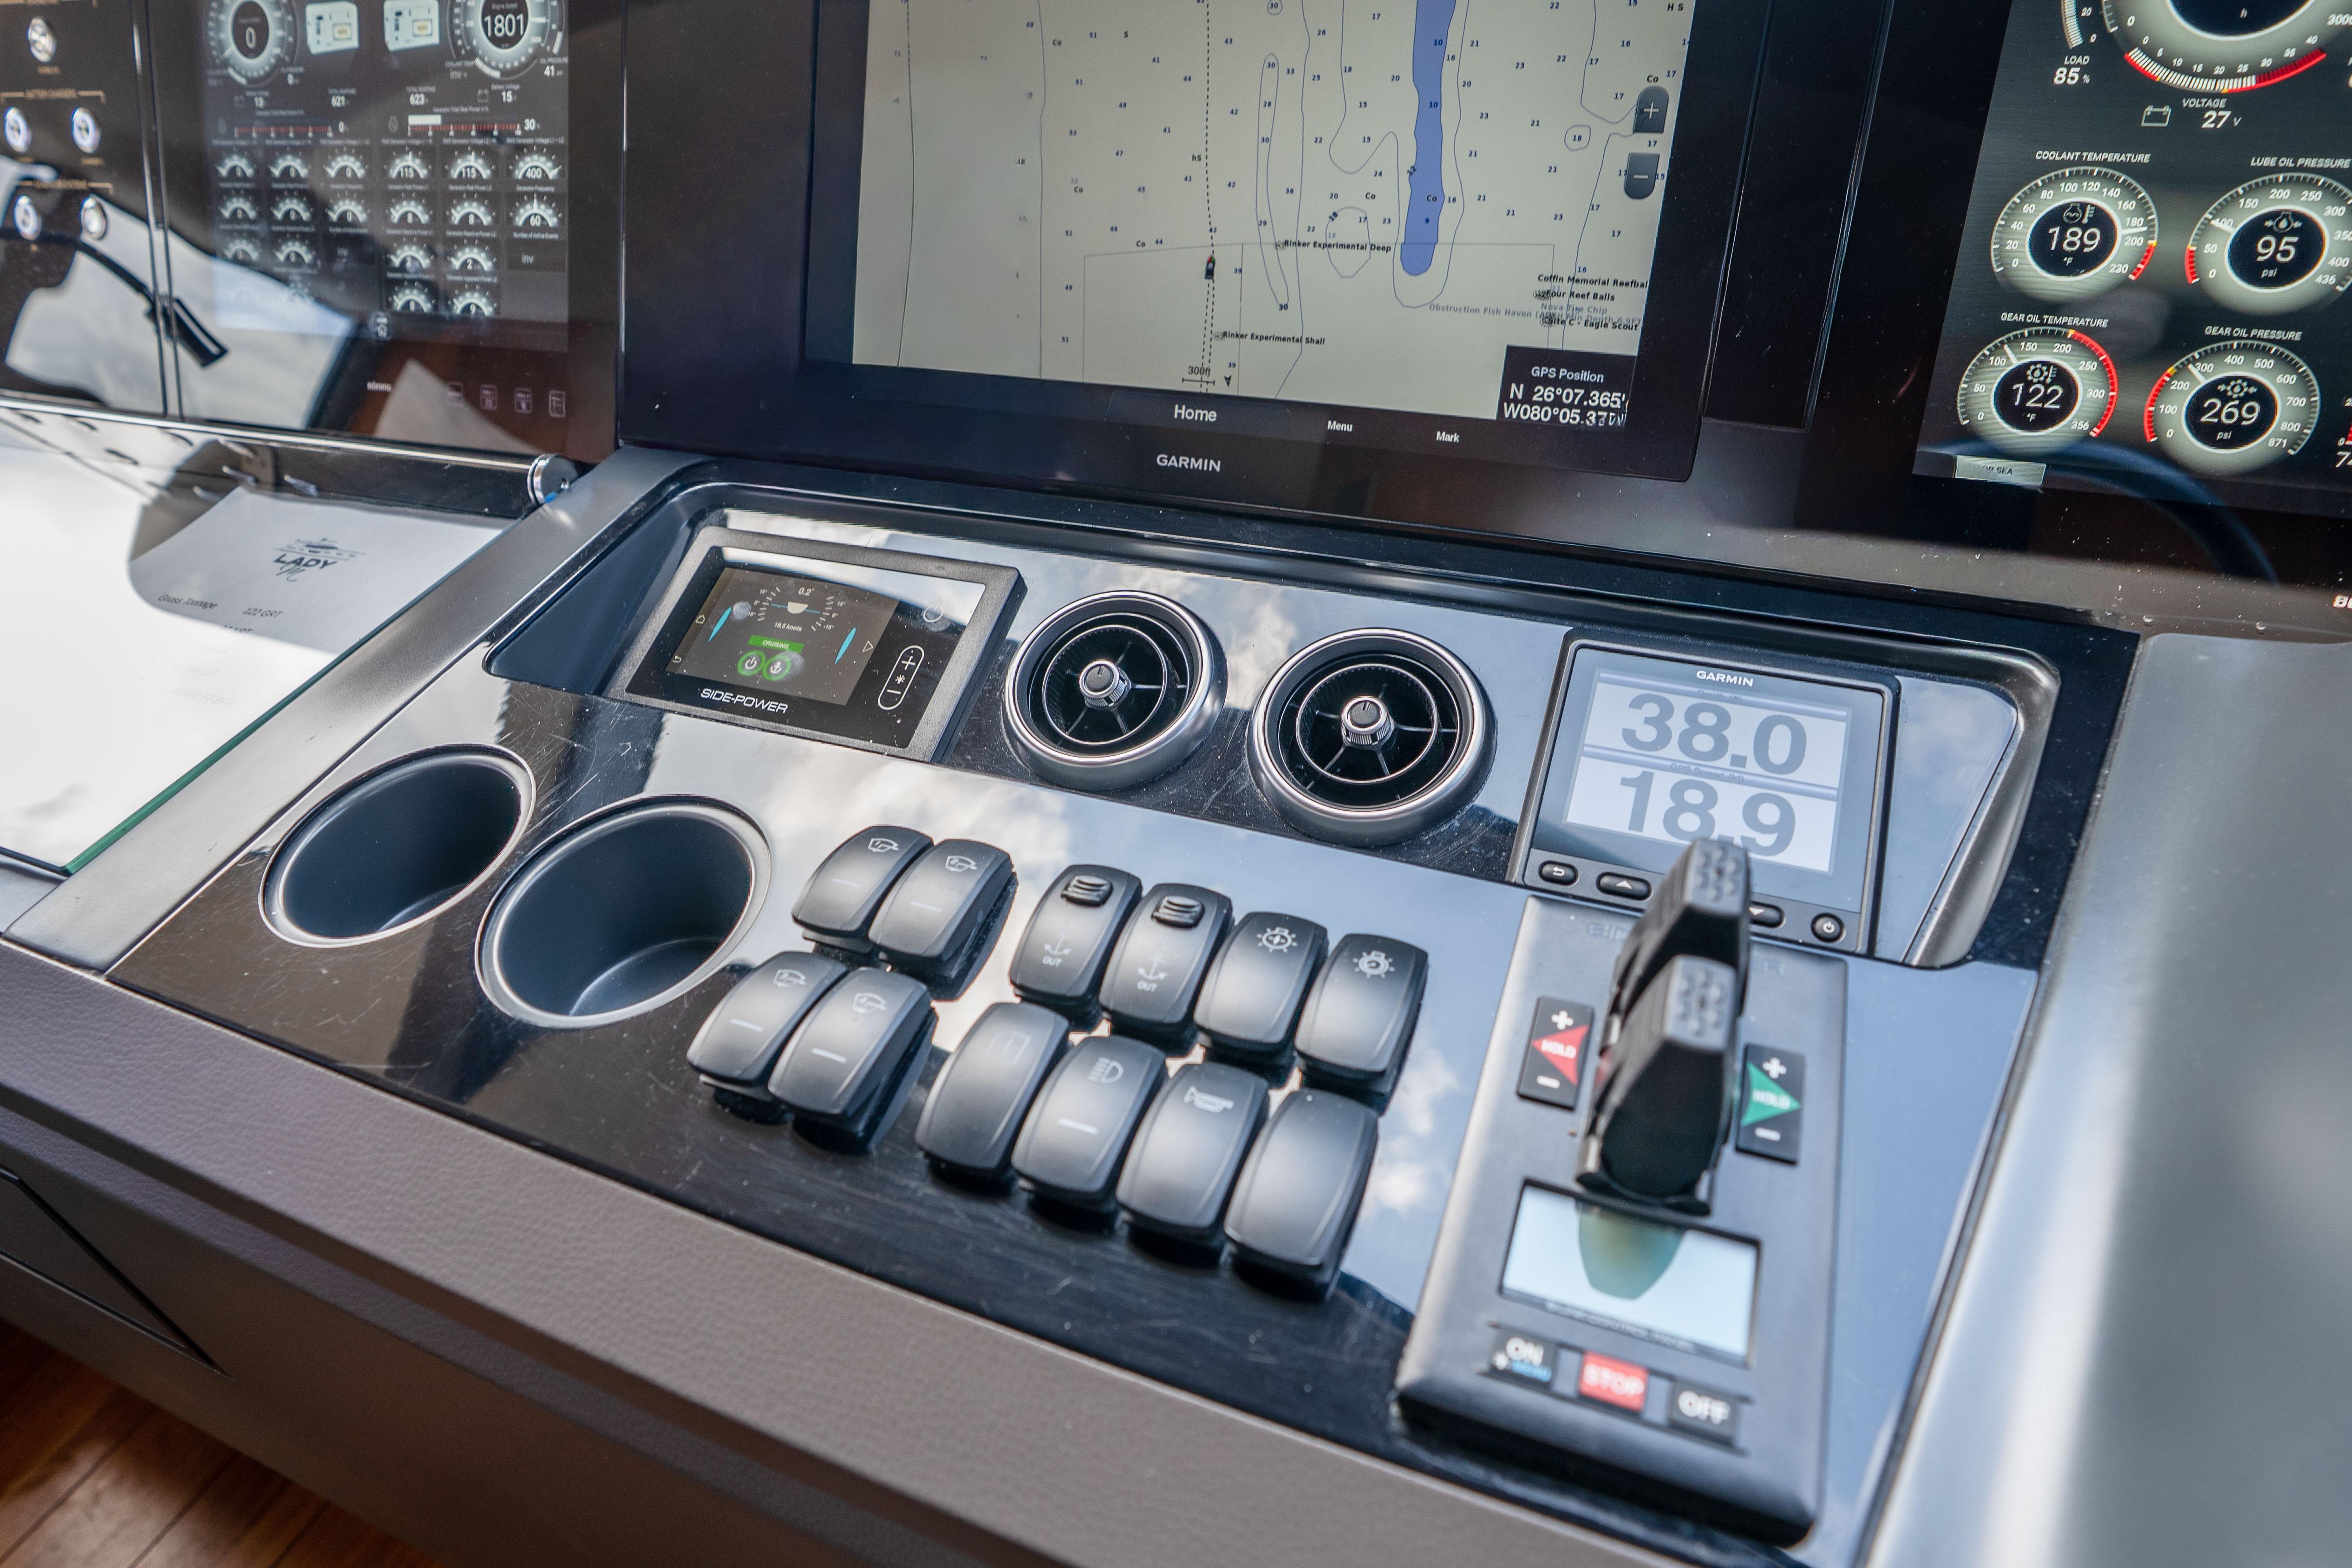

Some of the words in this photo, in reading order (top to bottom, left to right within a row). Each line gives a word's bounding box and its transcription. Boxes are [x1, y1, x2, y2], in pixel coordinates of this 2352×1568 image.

[2080, 7, 2092, 17] 20
[484, 13, 525, 38] 1801
[2127, 15, 2136, 27] 0
[2090, 33, 2097, 43] 0
[2142, 35, 2149, 45] 0
[2064, 55, 2090, 65] LOAD
[2172, 57, 2183, 67] 10
[543, 65, 555, 77] 41
[2053, 67, 2081, 85] 85
[2082, 74, 2091, 84] %
[1646, 74, 1659, 83] Co
[409, 93, 425, 105] 623
[2182, 98, 2228, 108] VOLTAGE
[523, 118, 536, 131] 30
[2201, 110, 2232, 129] 27
[2035, 150, 2081, 162] COOLANT
[2081, 151, 2152, 163] TEMPERATURE
[2250, 156, 2278, 167] LUBE
[2278, 157, 2295, 168] OIL
[2296, 157, 2352, 169] PRESSURE
[462, 167, 476, 178] 115
[525, 167, 542, 179] 400
[1074, 185, 1084, 194] Co
[2059, 182, 2078, 193] 100
[2082, 181, 2101, 192] 120
[2102, 187, 2121, 198] 140
[2040, 189, 2054, 200] 80
[2268, 188, 2291, 200] 200
[2300, 190, 2323, 202] 250
[2022, 203, 2036, 214] 60
[2117, 200, 2136, 211] 160
[2238, 197, 2260, 209] 150
[529, 215, 542, 227] 60
[2010, 220, 2024, 231] 40
[2125, 216, 2144, 228] 180
[2047, 225, 2101, 253] 189
[2123, 236, 2144, 247] 200
[1284, 239, 1311, 249] Rinker
[1313, 240, 1368, 252] Experimental
[1370, 243, 1392, 254] Deep
[2005, 240, 2019, 251] 20
[2203, 243, 2218, 254] 50
[2255, 235, 2299, 263] 95
[2011, 258, 2019, 268] 0
[2328, 256, 2350, 268] 400
[2208, 268, 2217, 279] 0
[2261, 268, 2278, 279] psi
[1537, 273, 1564, 284] Coffin
[1567, 275, 1610, 287] Memorial
[1569, 290, 1591, 301] Reef
[1592, 292, 1616, 302] Balls
[1429, 303, 1480, 315] Obstruction
[1483, 307, 1502, 315] Fish
[1504, 308, 1532, 318] Haven
[1541, 302, 1564, 312] Nova
[1587, 305, 1608, 316] Chip
[1583, 320, 1609, 330] Eagle
[1611, 320, 1639, 331] Scout
[2000, 312, 2025, 323] GEAR
[2025, 314, 2041, 324] OIL
[2042, 314, 2110, 328] TEMPERATURE
[1222, 330, 1248, 340] Rinker
[1250, 332, 1303, 345] Experimental
[1305, 335, 1326, 346] Shall
[2204, 325, 2231, 337] GEAR
[2232, 327, 2249, 338] OIL
[2249, 328, 2303, 341] PRESSURE
[2019, 341, 2038, 352] 150
[2052, 343, 2072, 354] 200
[1988, 356, 2007, 366] 100
[2078, 360, 2098, 372] 250
[2223, 354, 2245, 366] 400
[2253, 358, 2275, 369] 500
[1187, 365, 1212, 377] 300ft
[1531, 366, 1557, 379] GPS
[1558, 368, 1605, 383] Position
[2275, 373, 2298, 385] 600
[1509, 382, 1524, 400] N
[1973, 383, 1986, 394] 50
[2169, 380, 2191, 391] 200
[2012, 382, 2064, 409] 122
[2286, 396, 2307, 408] 700
[1174, 404, 1217, 423] Home
[2159, 404, 2178, 415] 100
[2199, 397, 2261, 426] 269
[1977, 412, 1985, 422] 0
[1326, 419, 1353, 432] Menu
[2071, 419, 2090, 431] 356
[2280, 421, 2301, 432] 800
[1436, 430, 1460, 444] Mark
[2166, 428, 2175, 439] 0
[2215, 430, 2233, 441] psi
[2267, 437, 2288, 449] 871
[2337, 437, 2346, 446] 0
[1156, 453, 1222, 472] GARMIN
[272, 553, 339, 570] LADY
[242, 608, 261, 616] 122
[762, 639, 790, 650] CRUISING
[1696, 669, 1755, 687] GARMIN
[700, 688, 789, 714] SIDE-POWER
[1621, 693, 1808, 776] 38.0
[1620, 770, 1797, 857] 18.9
[1042, 956, 1062, 967] OUT
[1137, 980, 1158, 992] OUT
[1540, 1038, 1577, 1060] HOLD
[1752, 1089, 1792, 1111] HOLD
[1505, 1336, 1545, 1366] ON
[1582, 1362, 1646, 1398] STOP
[1677, 1390, 1731, 1425] OFF
